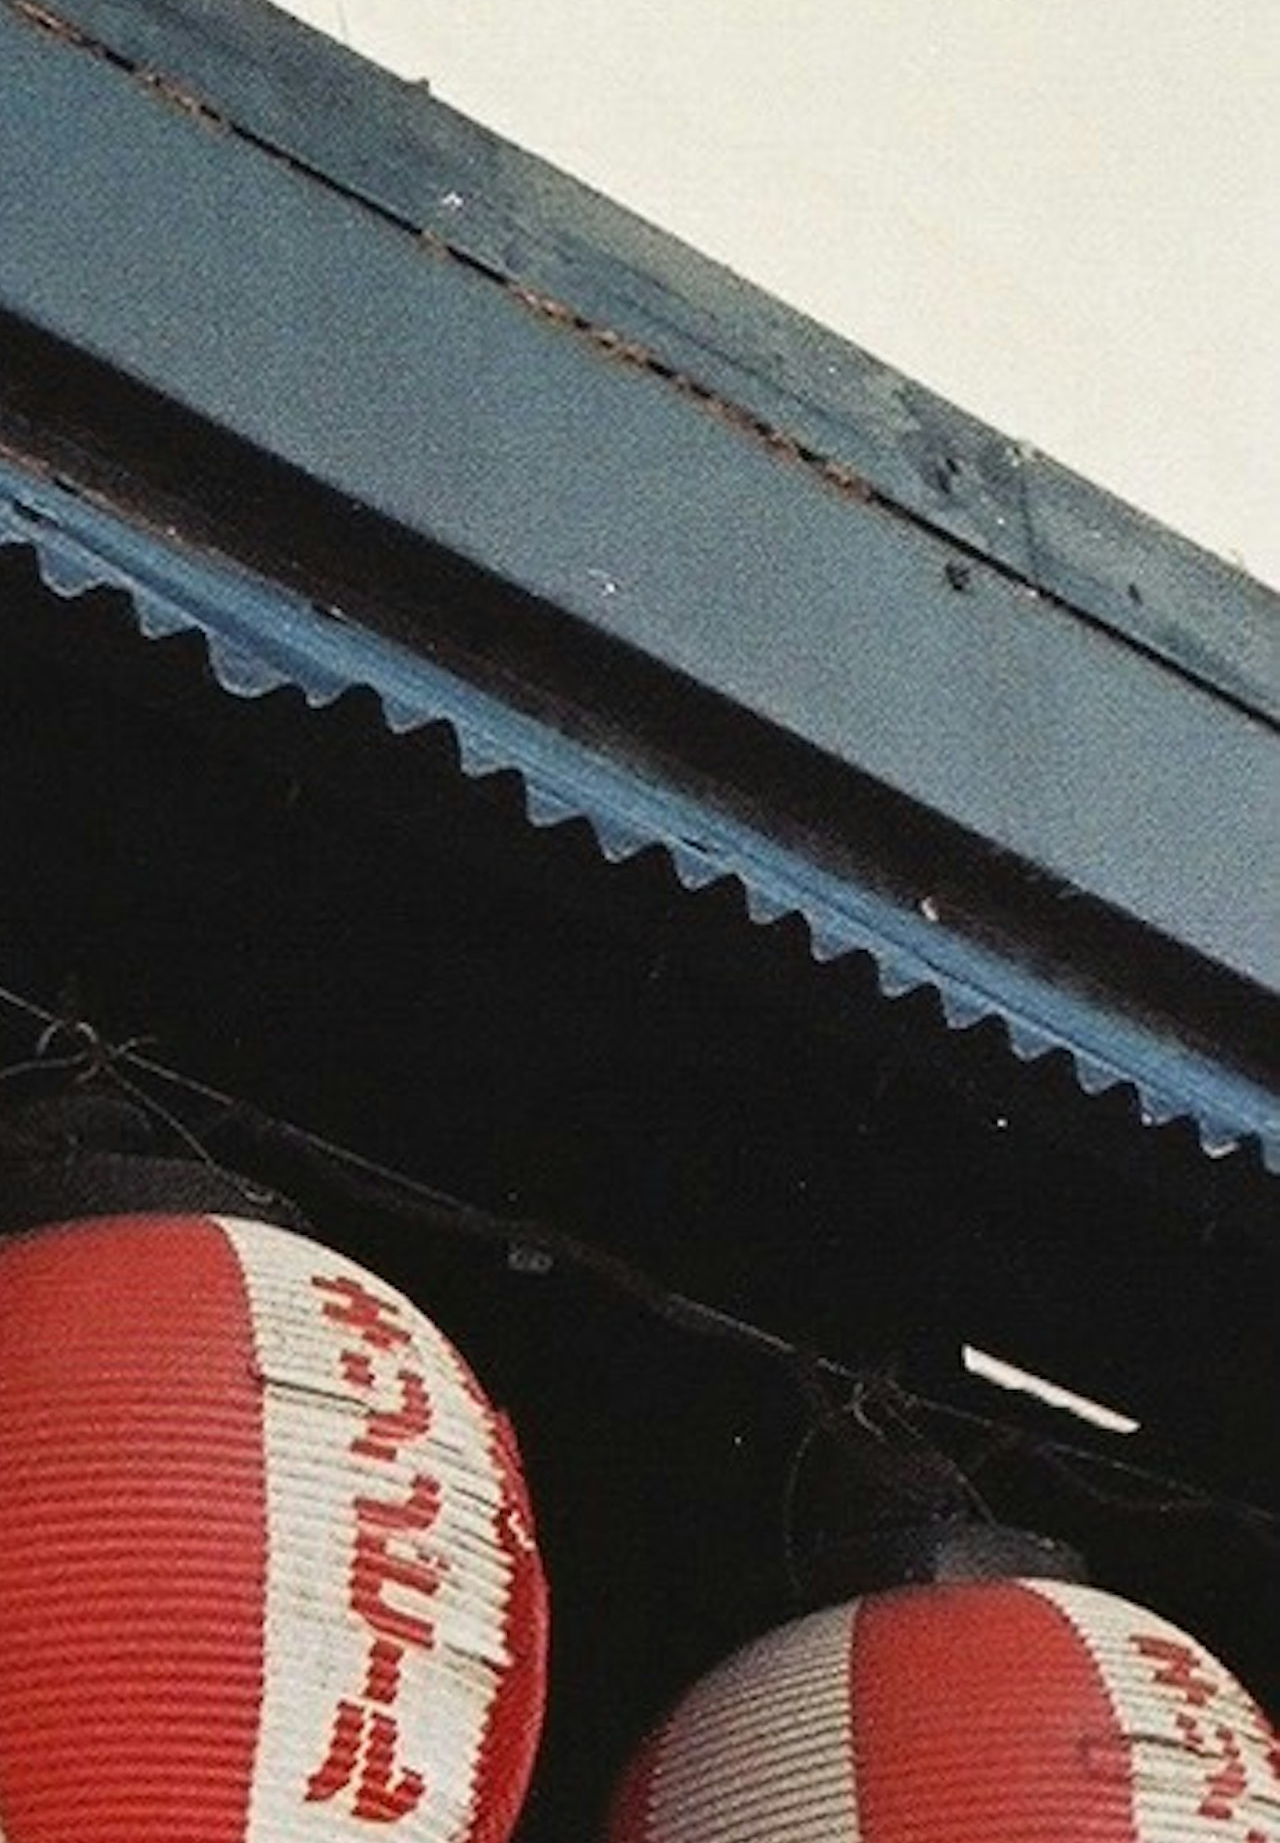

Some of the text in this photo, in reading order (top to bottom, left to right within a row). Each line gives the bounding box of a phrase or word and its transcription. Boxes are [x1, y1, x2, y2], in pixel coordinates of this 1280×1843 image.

[302, 1275, 449, 1824] キリンビール
